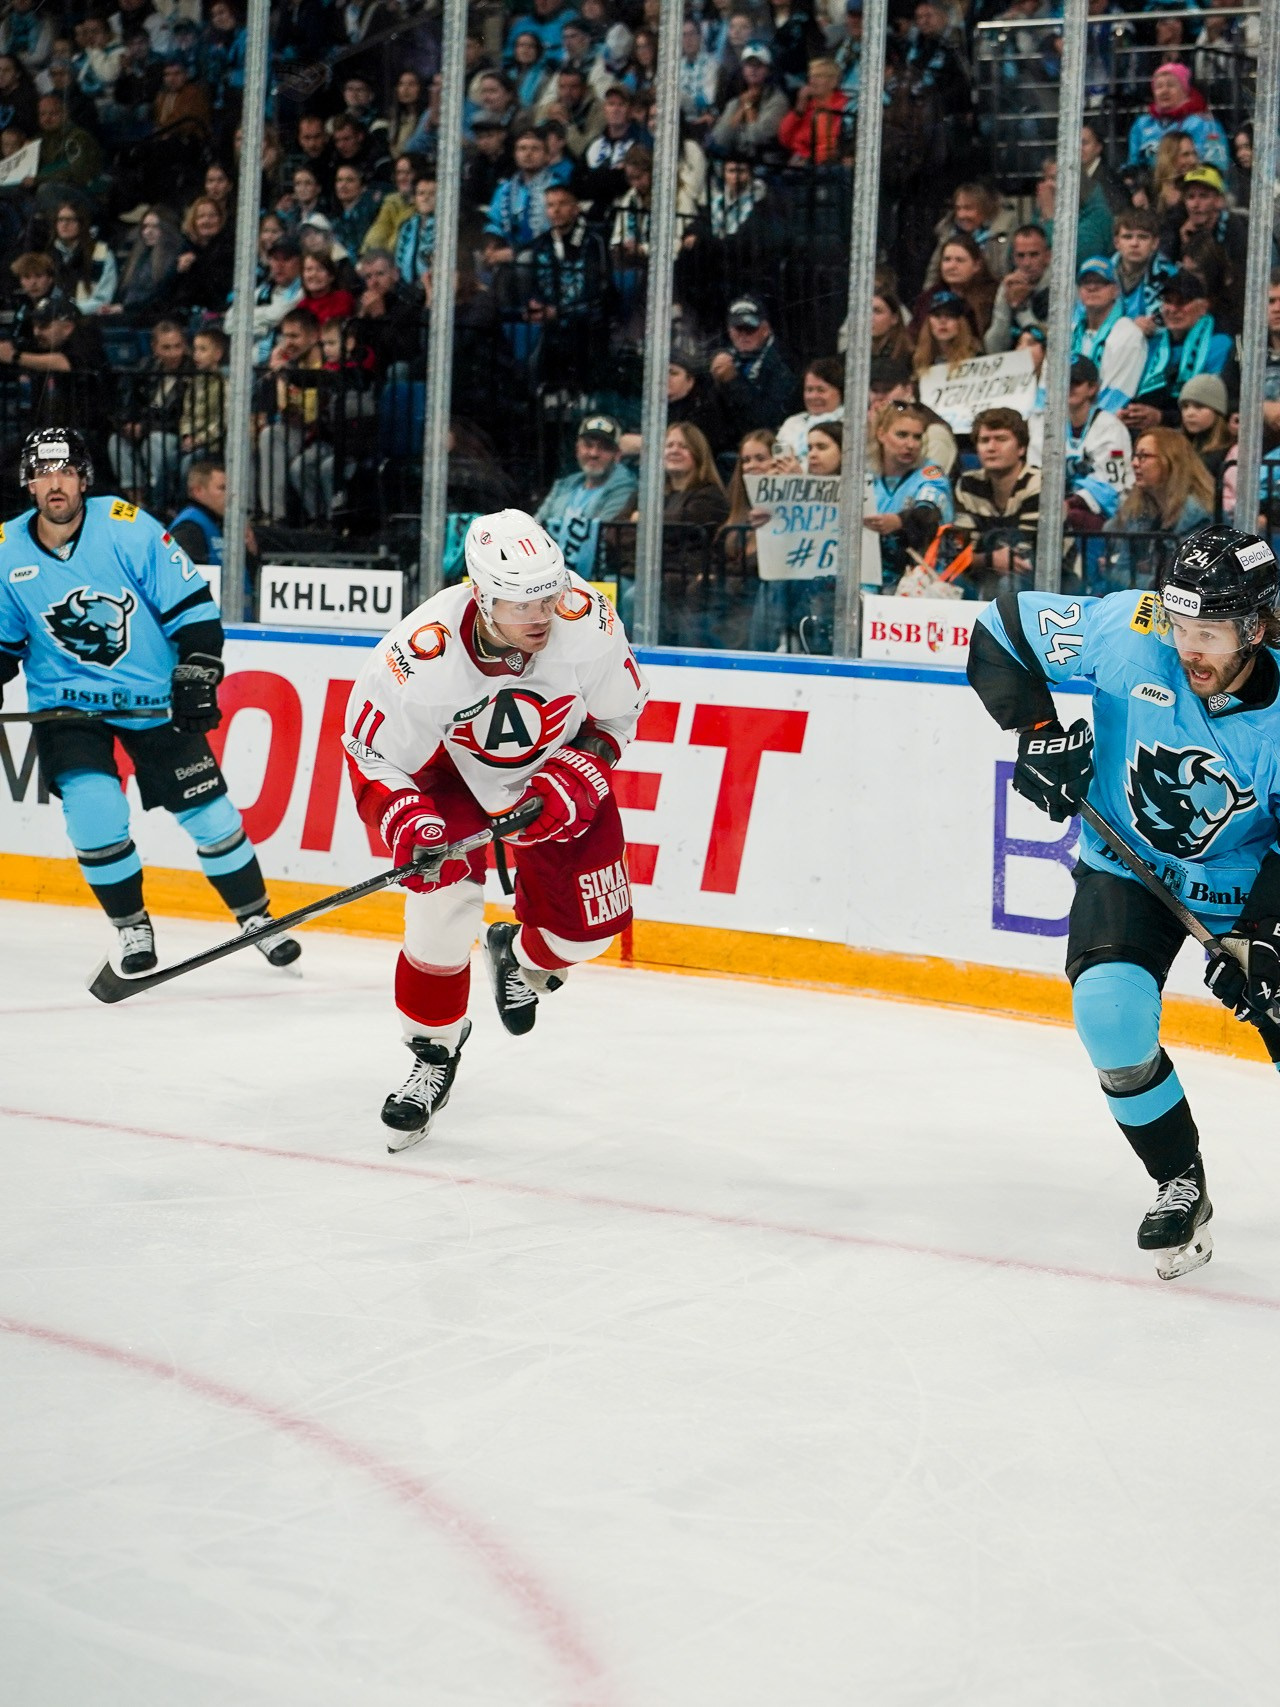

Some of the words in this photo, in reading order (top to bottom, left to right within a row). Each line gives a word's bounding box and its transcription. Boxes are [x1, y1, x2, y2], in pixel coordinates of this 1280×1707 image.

[517, 538, 537, 557] 11
[1183, 549, 1210, 569] 24
[270, 581, 393, 614] KHL.RU
[1165, 592, 1199, 611] согаз
[1257, 583, 1276, 600] CCM
[1134, 595, 1155, 629] LINE
[869, 620, 923, 644] BSB
[1038, 602, 1084, 666] 24
[391, 641, 416, 679] УГМК
[62, 688, 108, 705] BSB
[135, 694, 172, 706] Ban
[1141, 685, 1170, 702] МИР
[352, 699, 386, 749] 11
[1027, 726, 1094, 755] BAUE
[183, 777, 220, 800] CCM
[578, 859, 627, 900] SIMA
[1185, 880, 1250, 906] Bank
[582, 888, 629, 928] LAND
